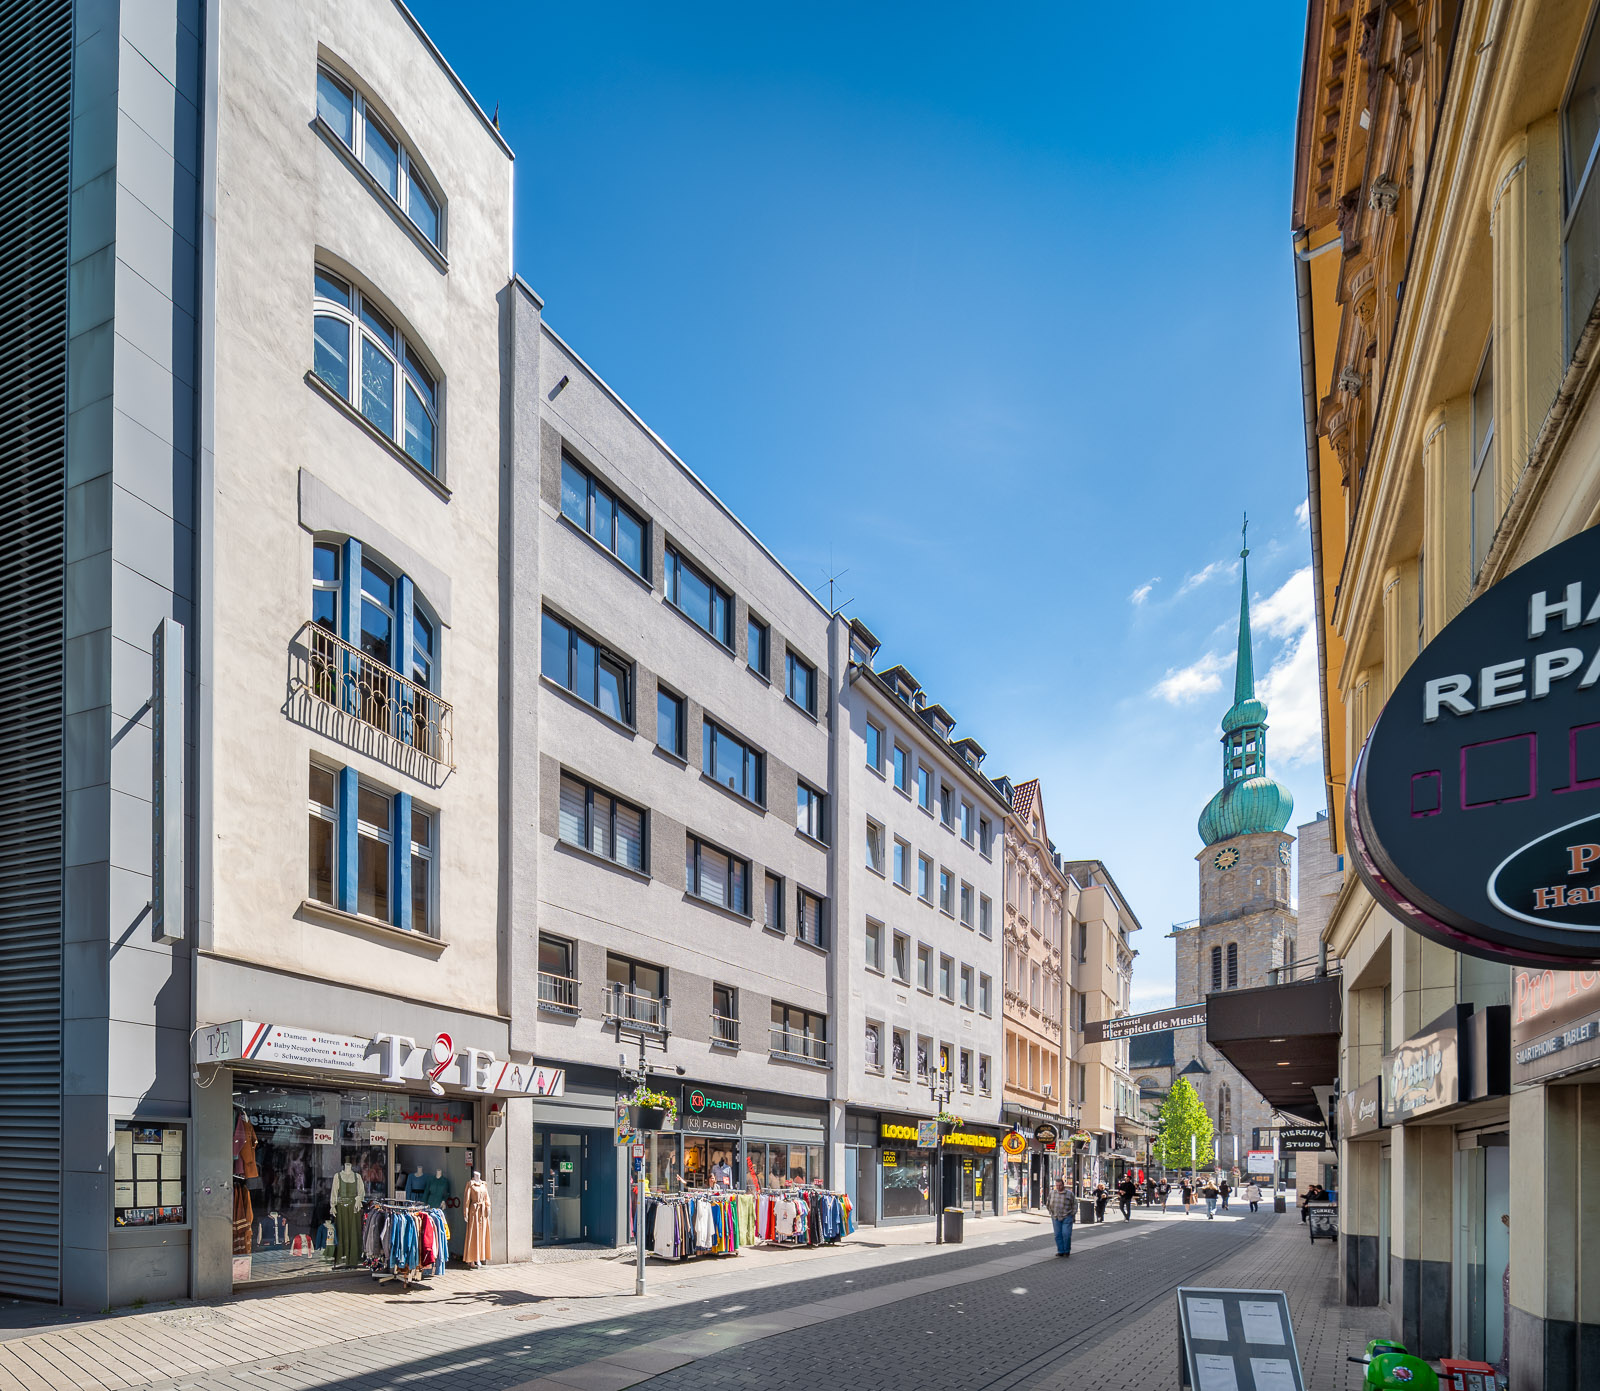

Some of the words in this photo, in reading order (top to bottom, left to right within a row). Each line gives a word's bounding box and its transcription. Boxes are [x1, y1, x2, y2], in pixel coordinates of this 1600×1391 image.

[1515, 970, 1555, 1024] Pro
[1102, 1018, 1141, 1030] Brückviertel
[1102, 1028, 1122, 1039] Hier
[1123, 1025, 1151, 1036] spielt
[1152, 1020, 1168, 1031] die
[1170, 1013, 1207, 1028] Musik!
[283, 1032, 307, 1041] Damen
[318, 1037, 340, 1046] Herren
[1516, 1037, 1557, 1064] SMARTPHONE
[1562, 1022, 1591, 1047] TABLET
[274, 1042, 290, 1051] Baby
[291, 1044, 330, 1055] Neugeboren
[281, 1053, 355, 1067] Schwangerschaftsmode
[1390, 1049, 1442, 1099] Prestige
[691, 1095, 704, 1107] KR
[705, 1098, 744, 1111] FASHION
[409, 1123, 455, 1133] WELCOME
[689, 1118, 700, 1128] KR
[702, 1120, 737, 1130] FASHION
[1280, 1129, 1325, 1138] PIERCING
[978, 1135, 997, 1148] CLUB
